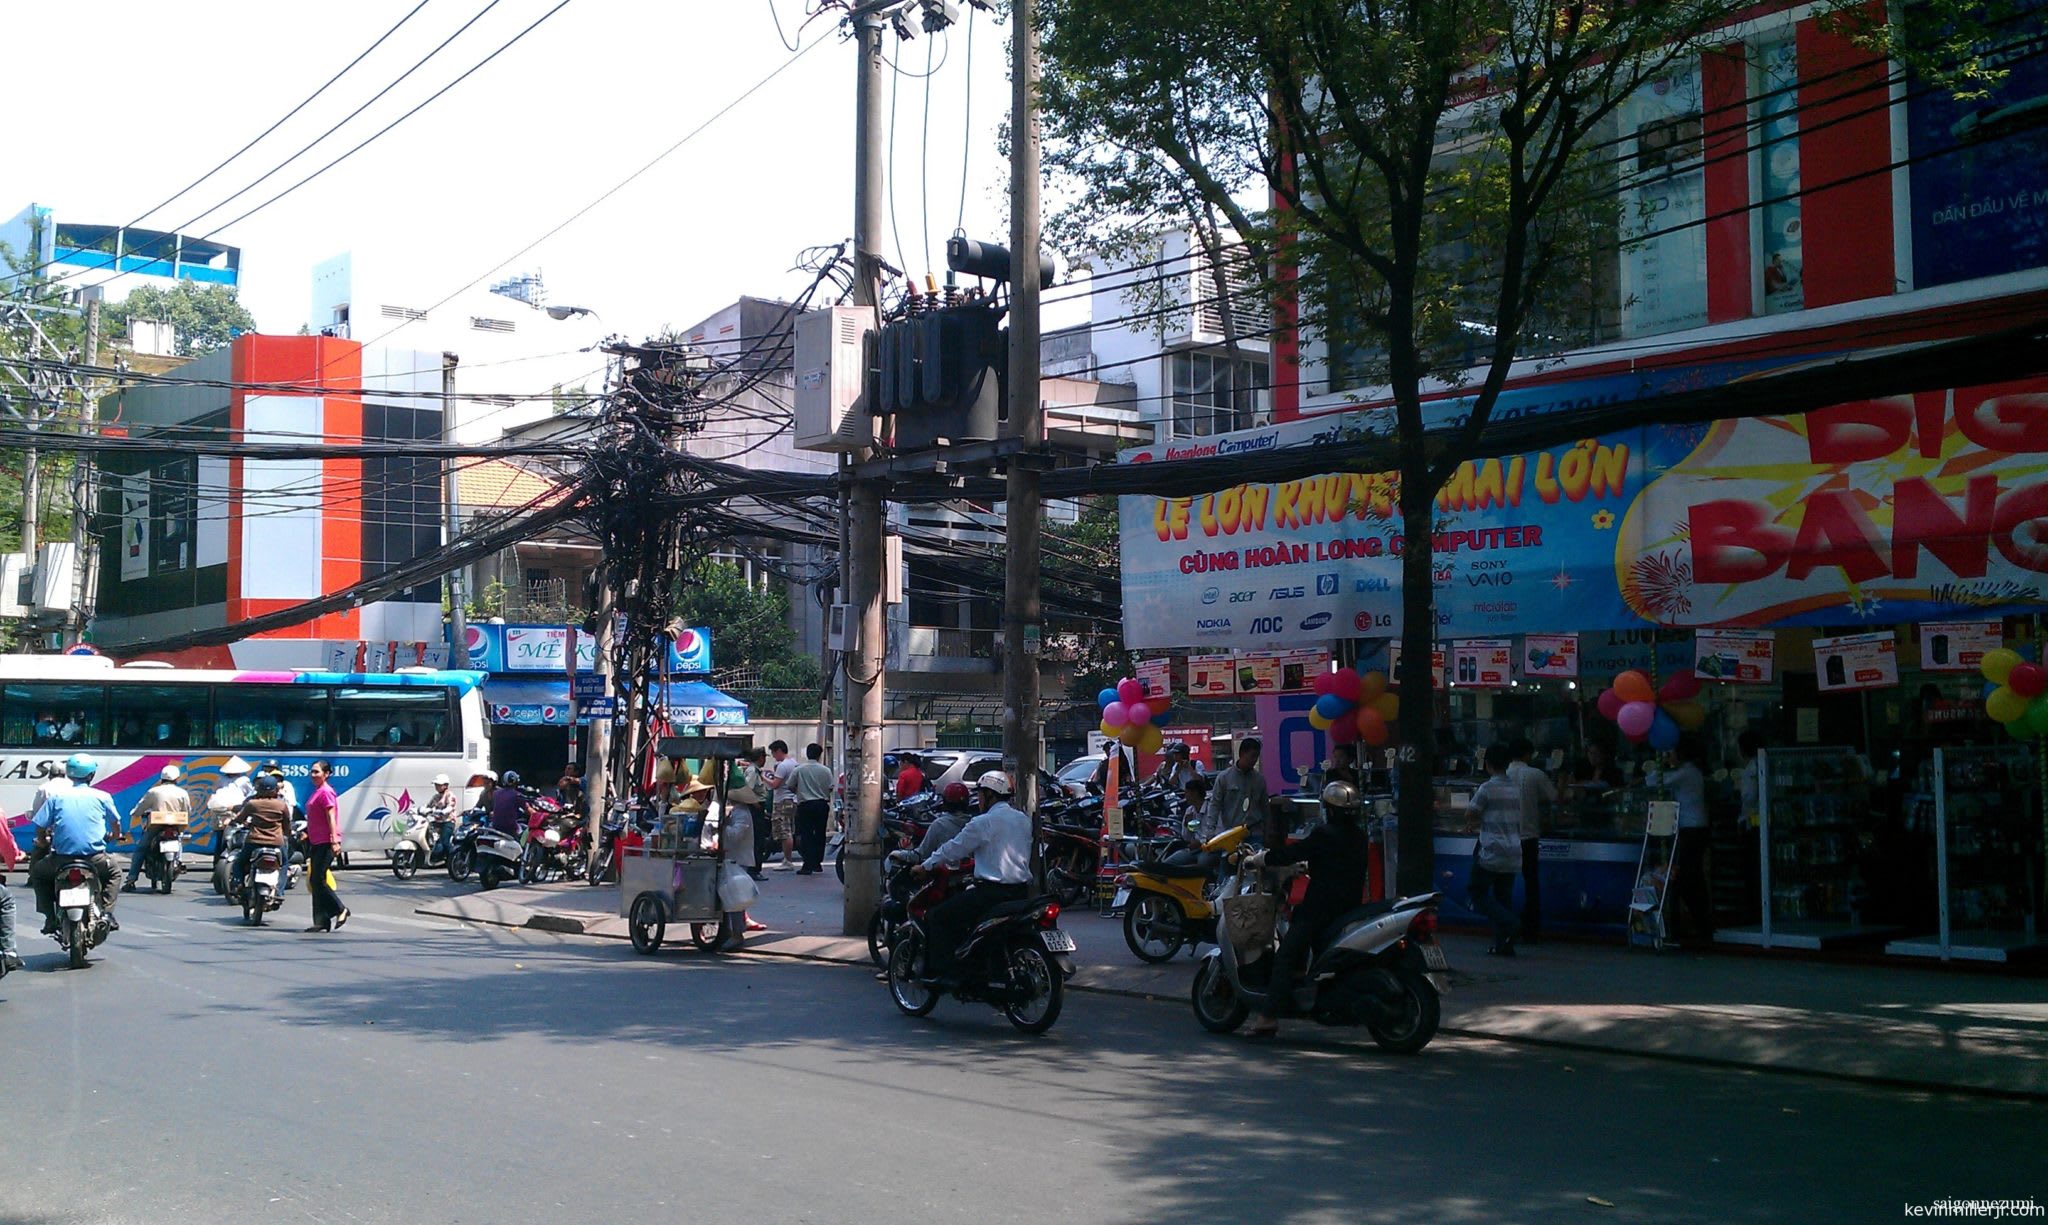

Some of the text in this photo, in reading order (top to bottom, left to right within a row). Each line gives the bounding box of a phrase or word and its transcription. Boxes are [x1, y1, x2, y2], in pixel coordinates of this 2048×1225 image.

[1179, 524, 1543, 575] CÙNG HOÀN LONG CMPUTER
[1471, 560, 1507, 570] SONY
[1229, 590, 1256, 603] acer
[1269, 586, 1305, 601] ASUS
[1357, 578, 1391, 593] DELL
[1197, 618, 1231, 629] NOKIA
[1375, 615, 1391, 627] LG
[467, 661, 489, 671] epsi
[676, 661, 701, 671] pepsi
[720, 709, 747, 719] pepsi
